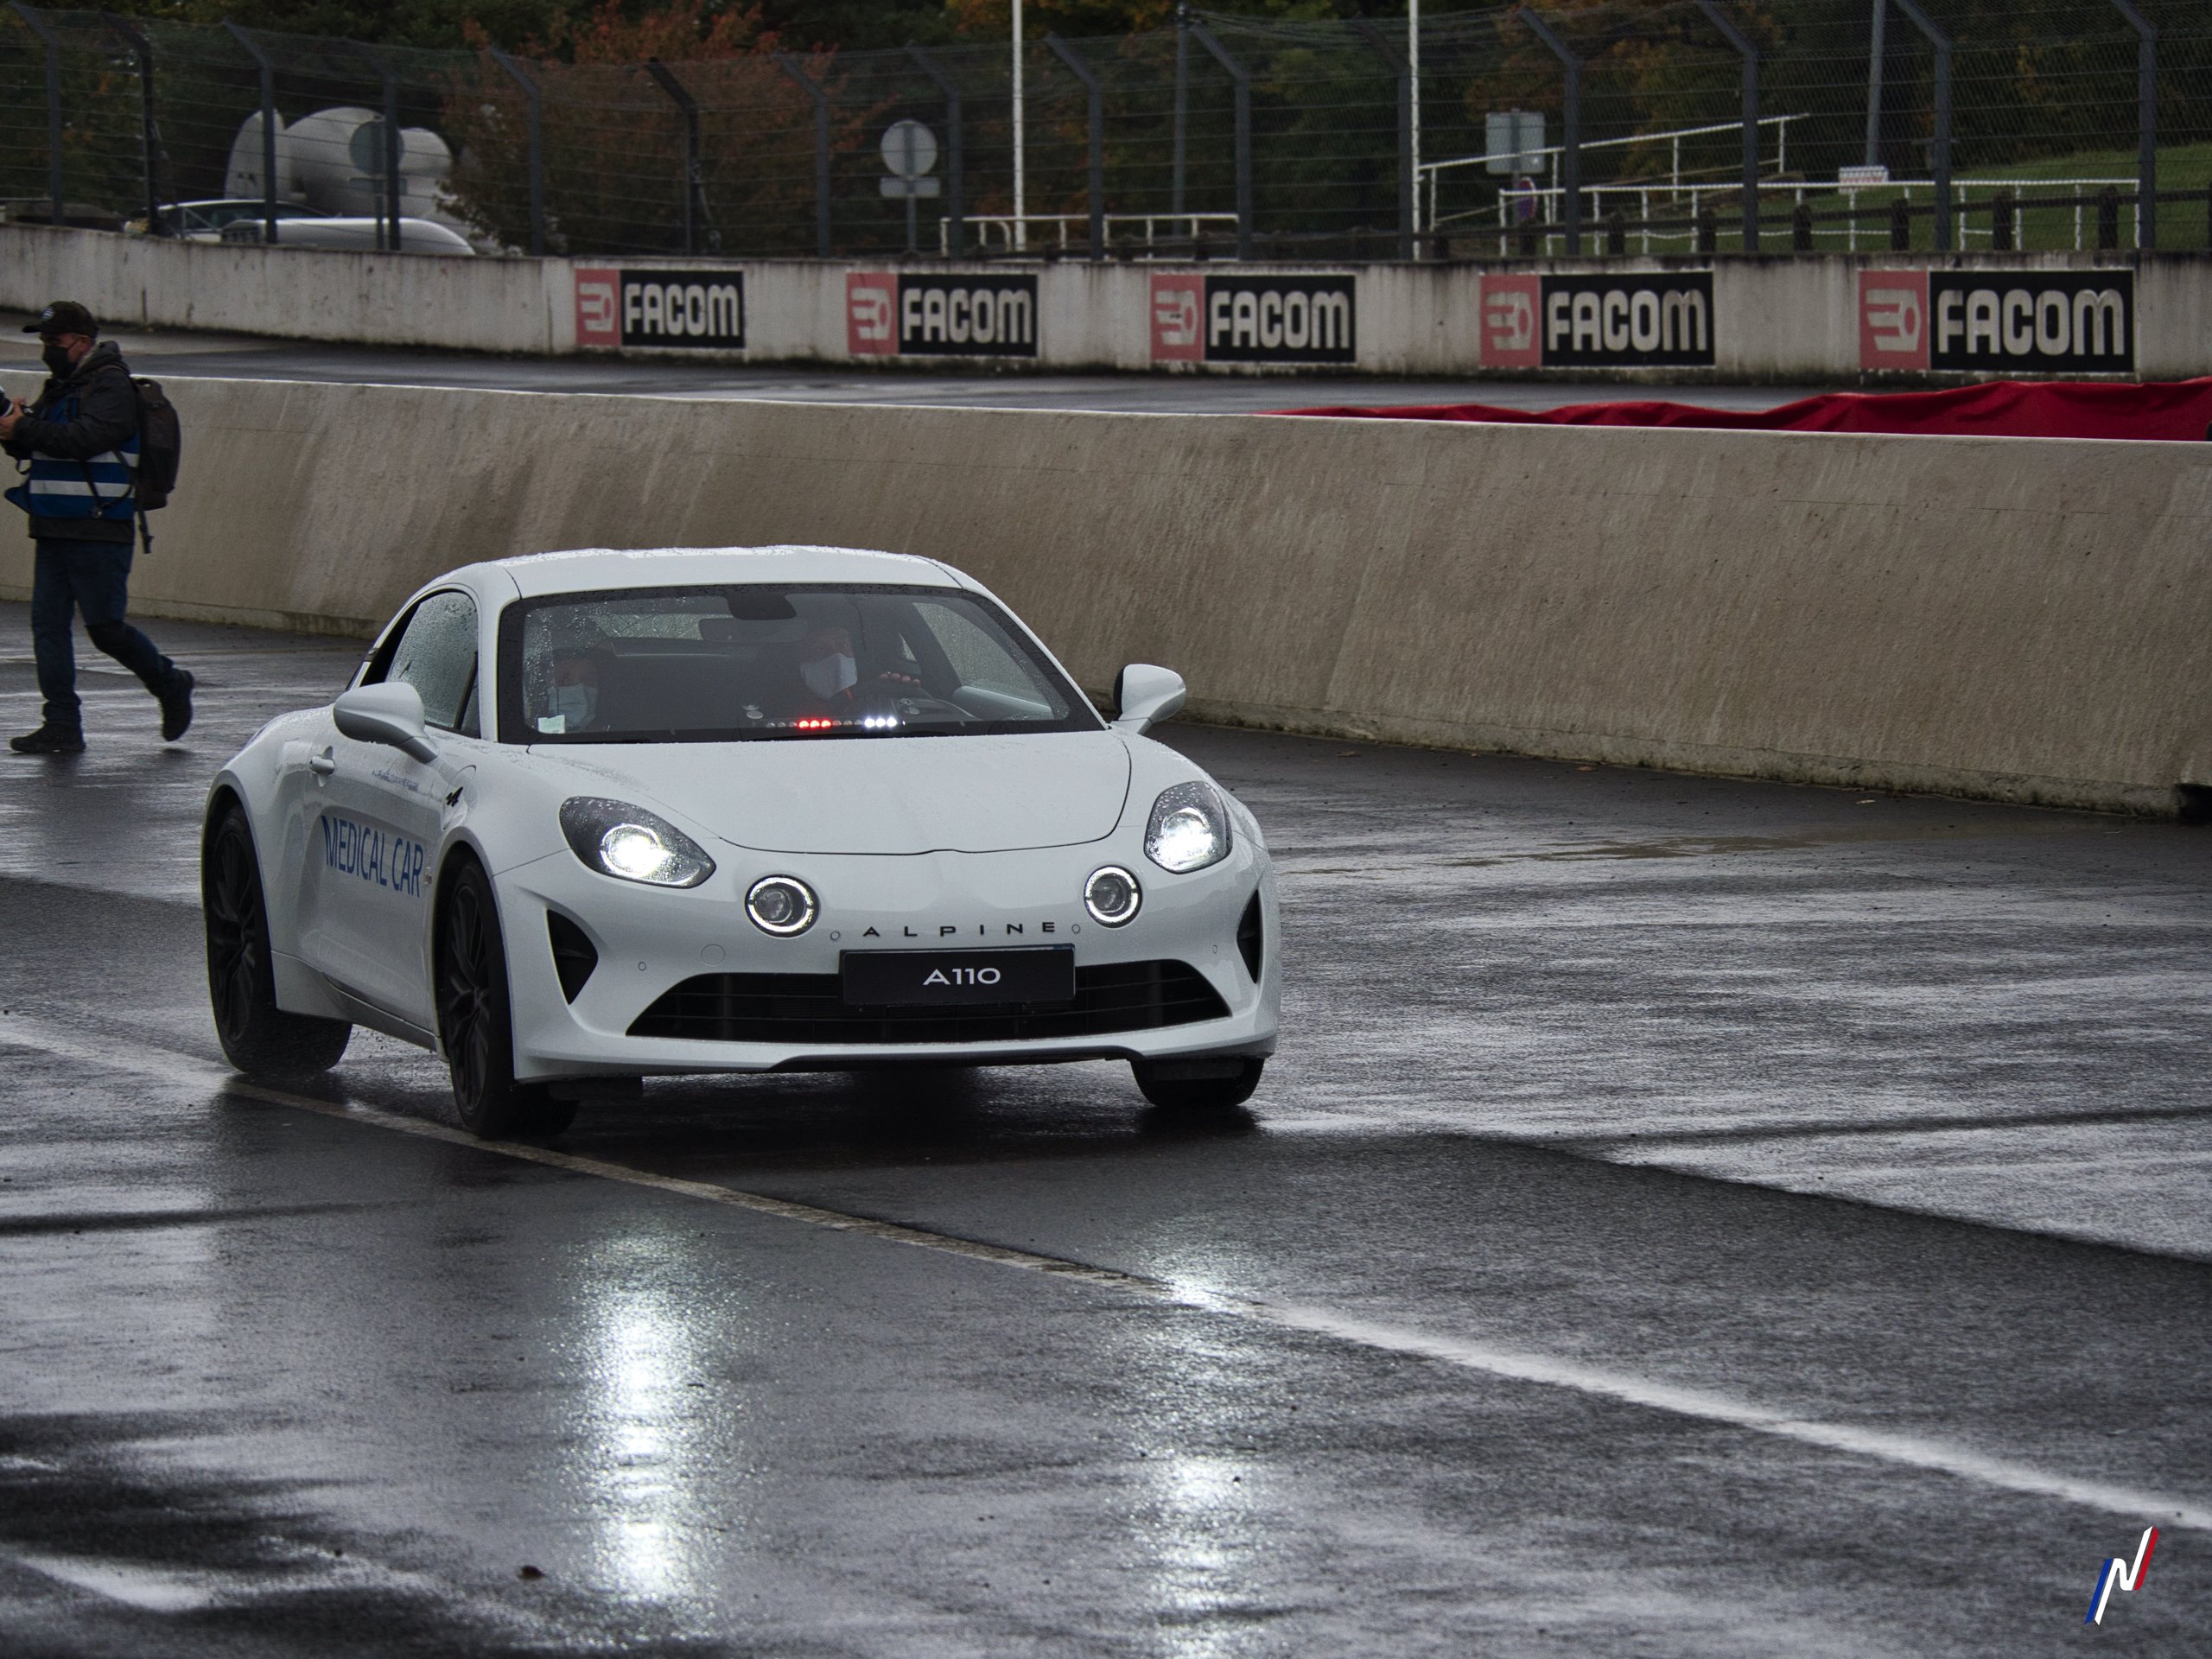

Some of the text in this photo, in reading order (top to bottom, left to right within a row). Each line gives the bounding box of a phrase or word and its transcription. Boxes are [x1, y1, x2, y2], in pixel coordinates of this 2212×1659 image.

[624, 283, 741, 337] FACOM
[901, 288, 1033, 344] FACOM
[1210, 289, 1350, 349] FACOM
[1547, 289, 1707, 351] FACOM
[1937, 289, 2125, 356] FACOM
[321, 815, 424, 898] MEDICAL CAR
[862, 921, 1055, 938] ALPINE
[922, 967, 1001, 986] A110
